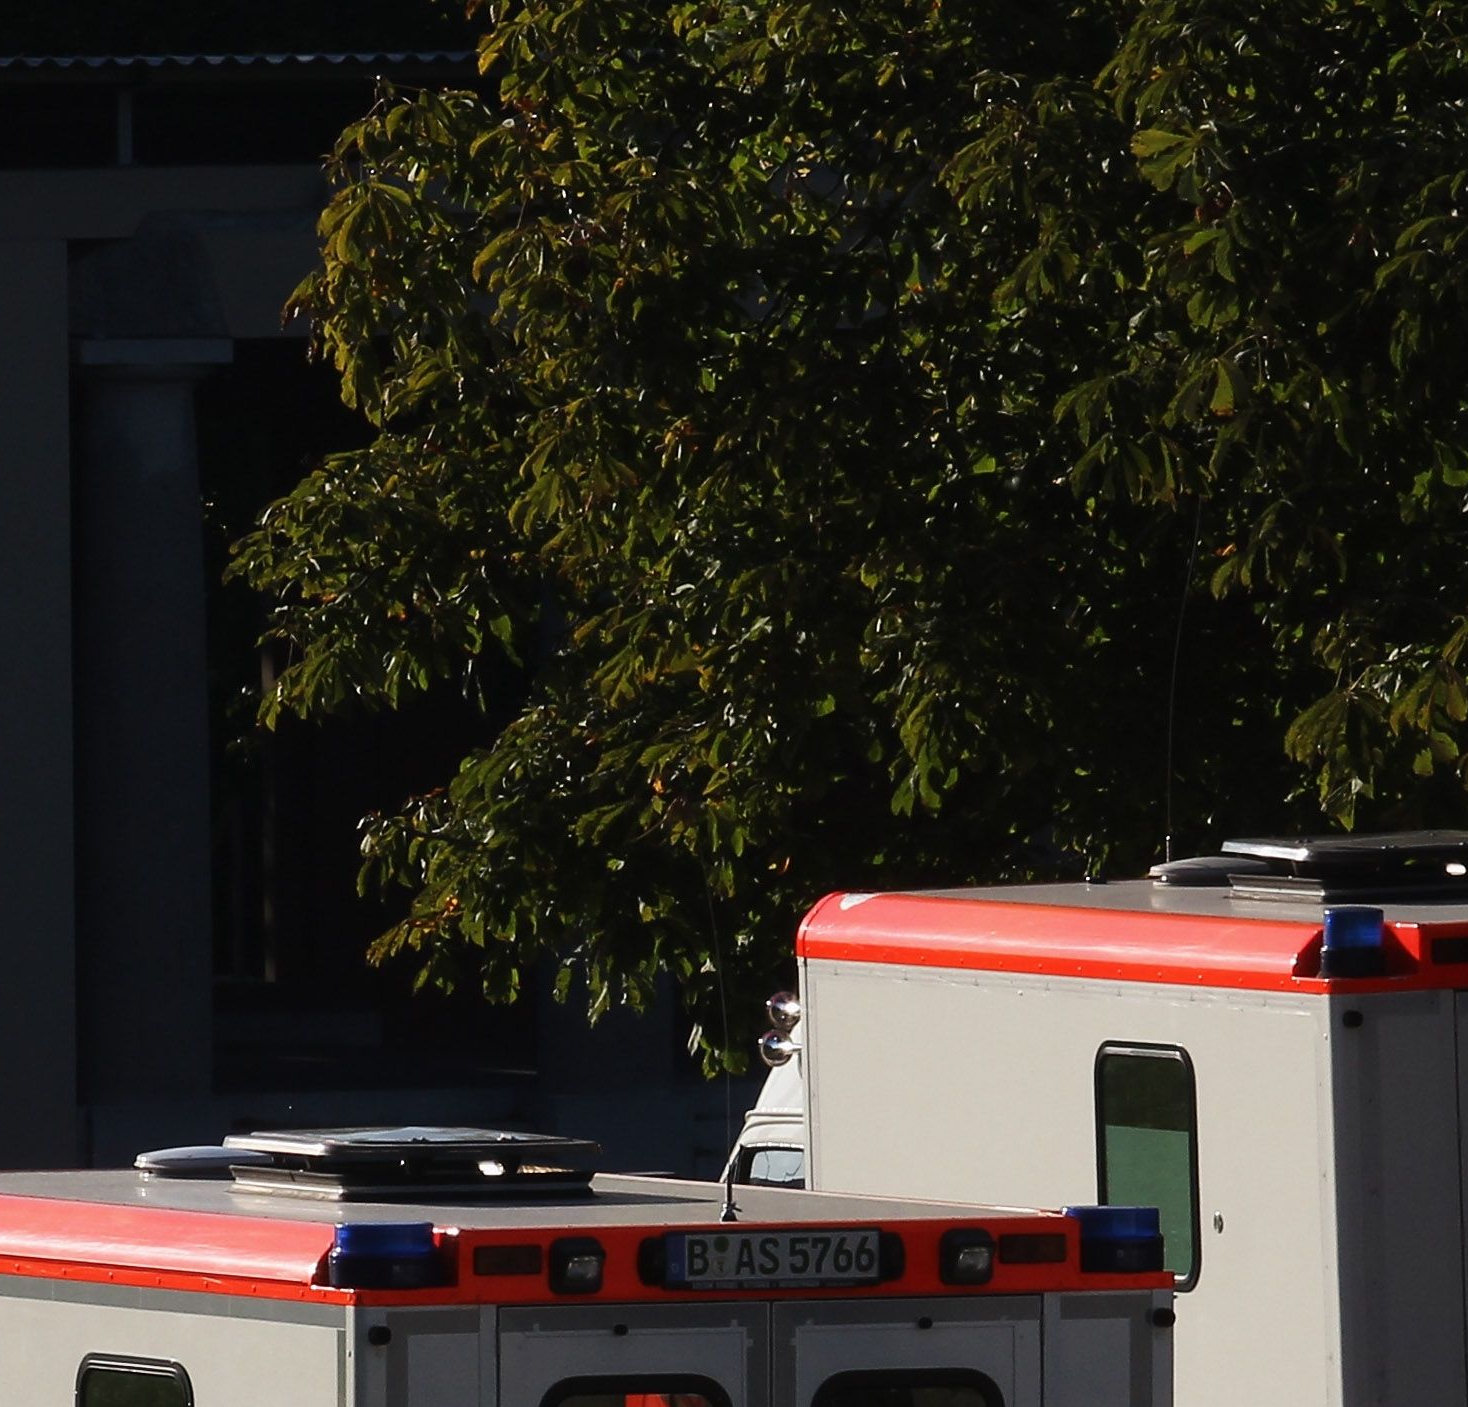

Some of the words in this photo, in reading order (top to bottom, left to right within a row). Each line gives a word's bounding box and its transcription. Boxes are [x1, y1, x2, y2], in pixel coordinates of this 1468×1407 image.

[687, 1239, 709, 1276] B
[735, 1237, 780, 1275] AS
[788, 1236, 875, 1274] 5766
